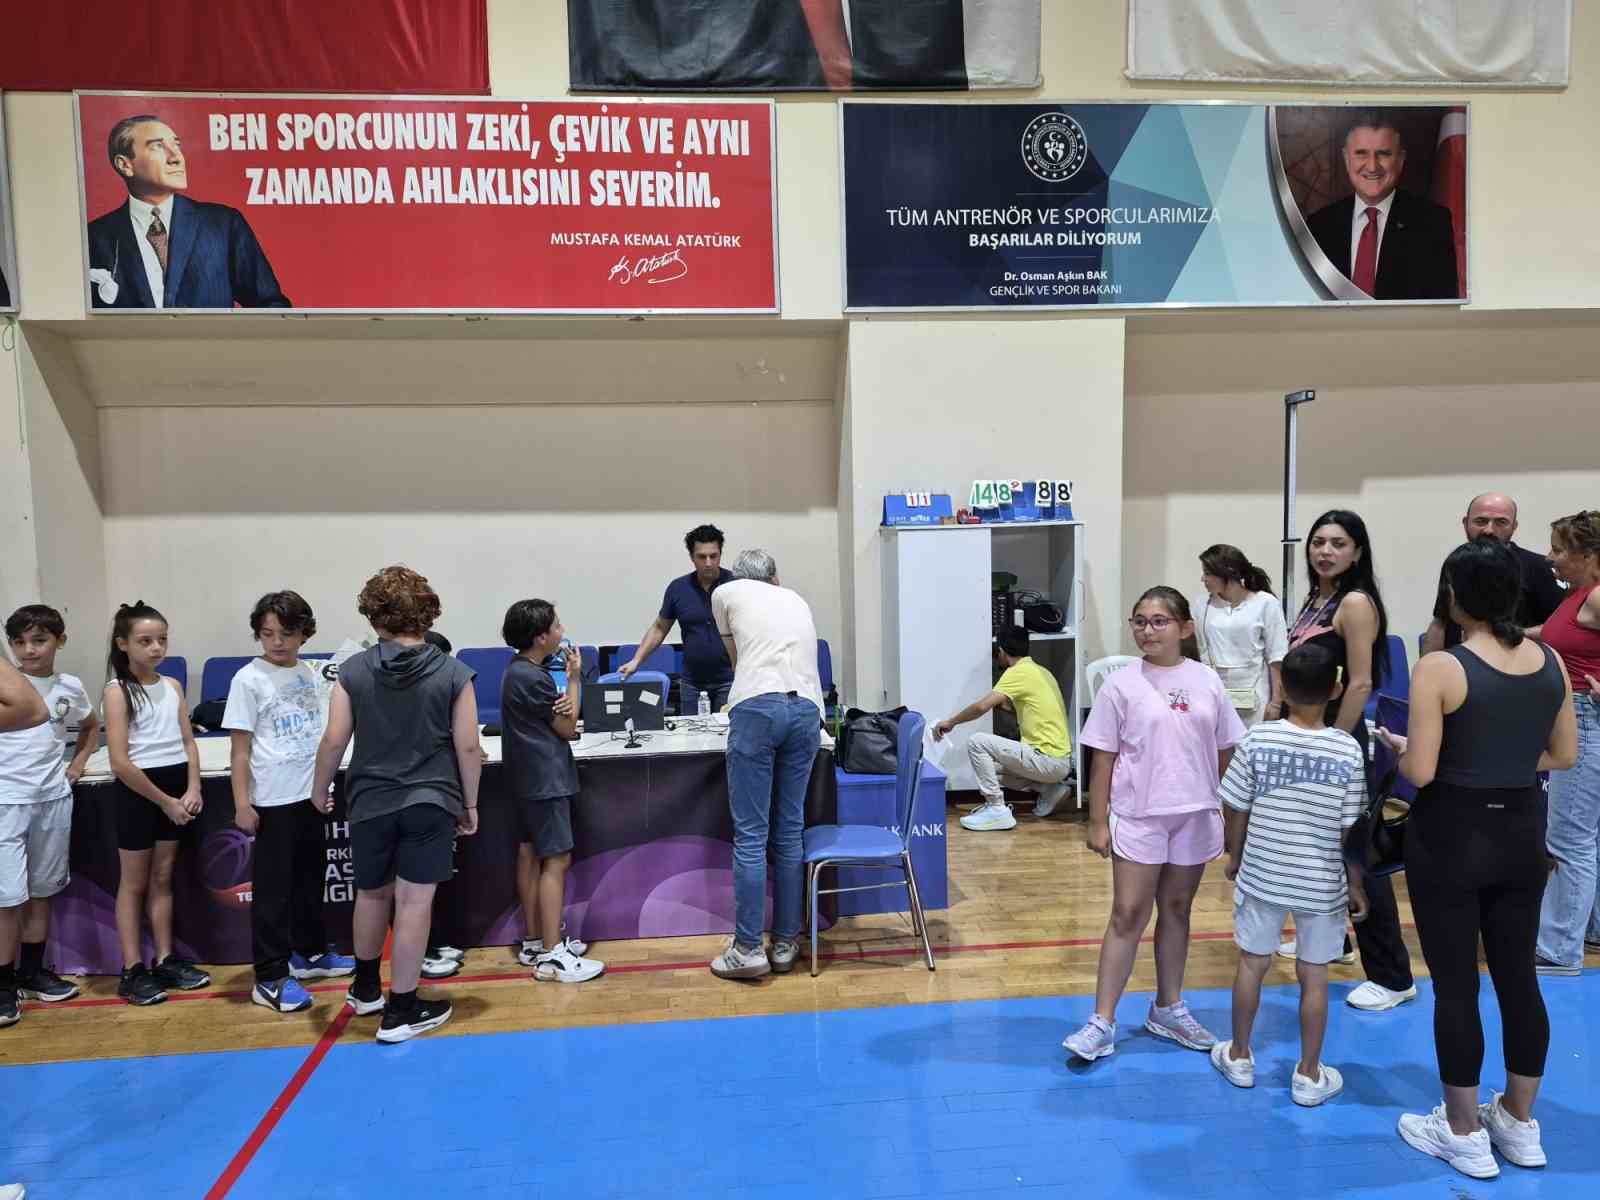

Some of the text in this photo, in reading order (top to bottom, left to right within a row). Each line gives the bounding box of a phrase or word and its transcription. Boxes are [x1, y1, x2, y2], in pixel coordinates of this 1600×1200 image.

[208, 104, 750, 162] BEN SPORCUNUN ZEKİ, ÇEVİK VE AYNI
[245, 160, 721, 208] ZAMANDA AHLAKLISINI SEVERİM.
[886, 205, 1222, 226] TÜM ANTRENÖR VE SPORCULARIMIZA
[550, 232, 742, 248] MUSTAFA KEMAL ATATÜRK
[969, 231, 1142, 250] BAŞARILAR DİLİYORUM
[1004, 270, 1108, 283] Dr. Osman Aşkın BAK
[990, 283, 1123, 298] GENÇLİK VE SPOR BAKANI
[999, 484, 1010, 501] 8
[1039, 481, 1070, 501] 8 8
